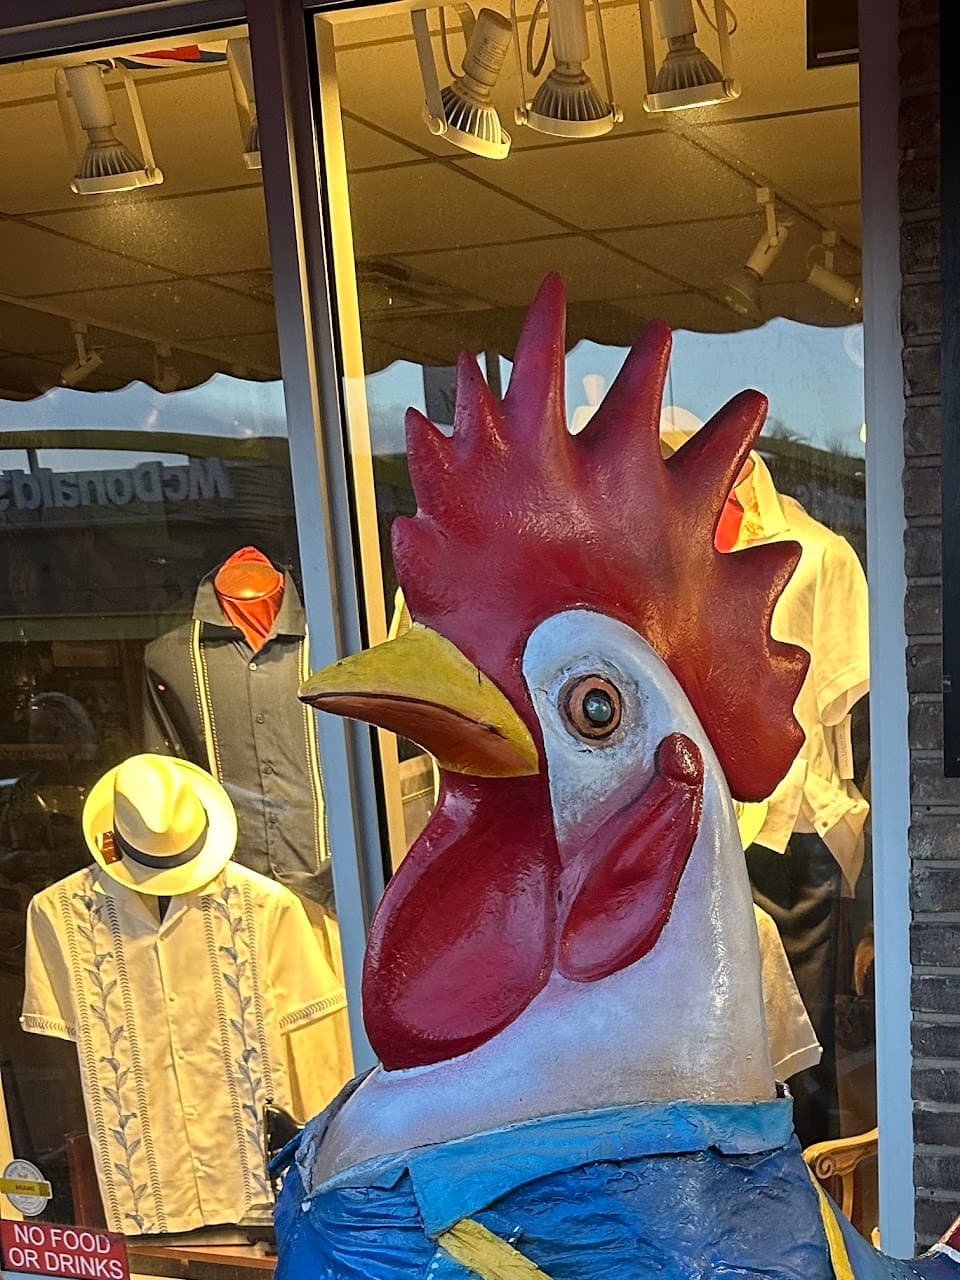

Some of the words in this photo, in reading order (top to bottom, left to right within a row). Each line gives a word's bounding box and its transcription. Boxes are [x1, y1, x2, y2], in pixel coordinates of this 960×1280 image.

[13, 1223, 45, 1246] NO
[50, 1228, 111, 1254] FOOD
[8, 1247, 40, 1268] OR
[45, 1251, 124, 1280] DRINKS
